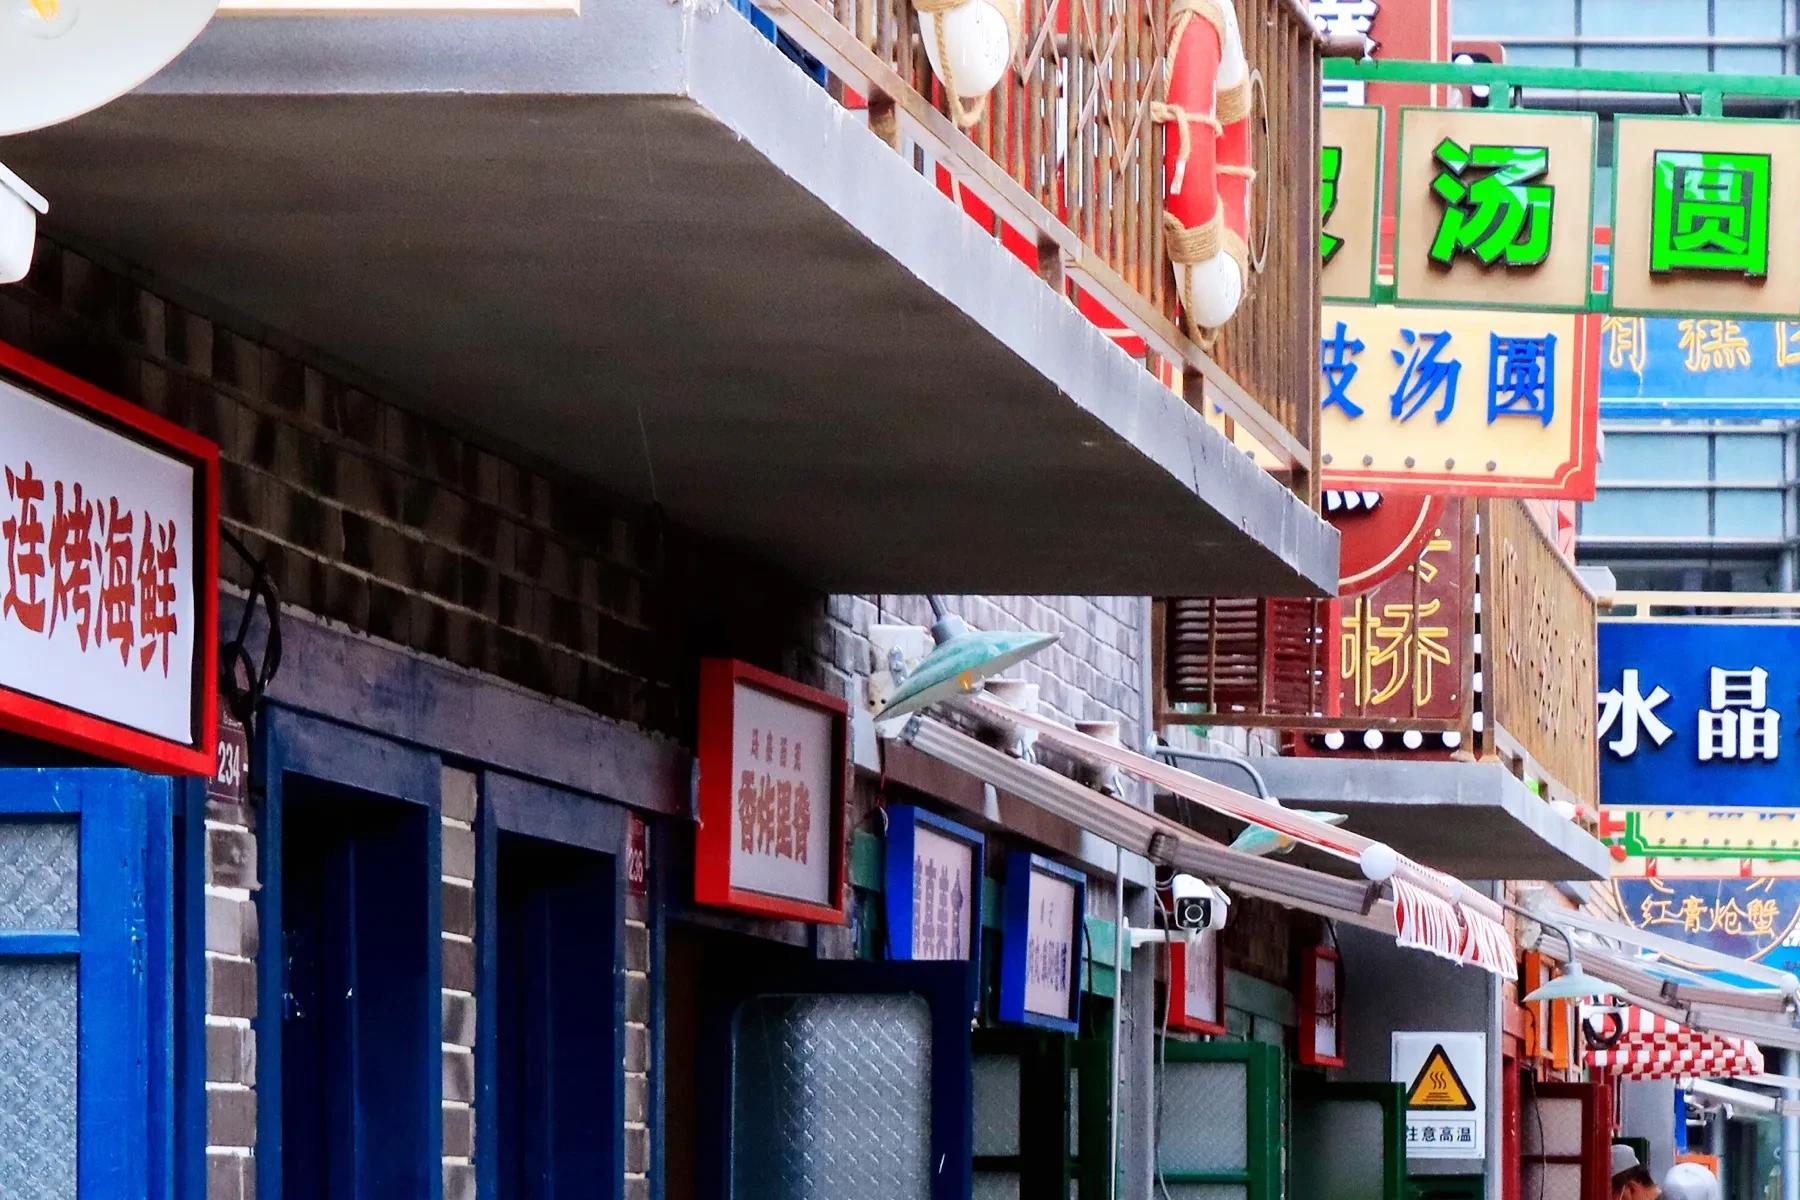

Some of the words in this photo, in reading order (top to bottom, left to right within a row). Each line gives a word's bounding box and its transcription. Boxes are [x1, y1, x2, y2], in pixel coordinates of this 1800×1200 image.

[2, 460, 178, 679] 连烤海鲜
[1407, 1126, 1472, 1143] 注意高温
